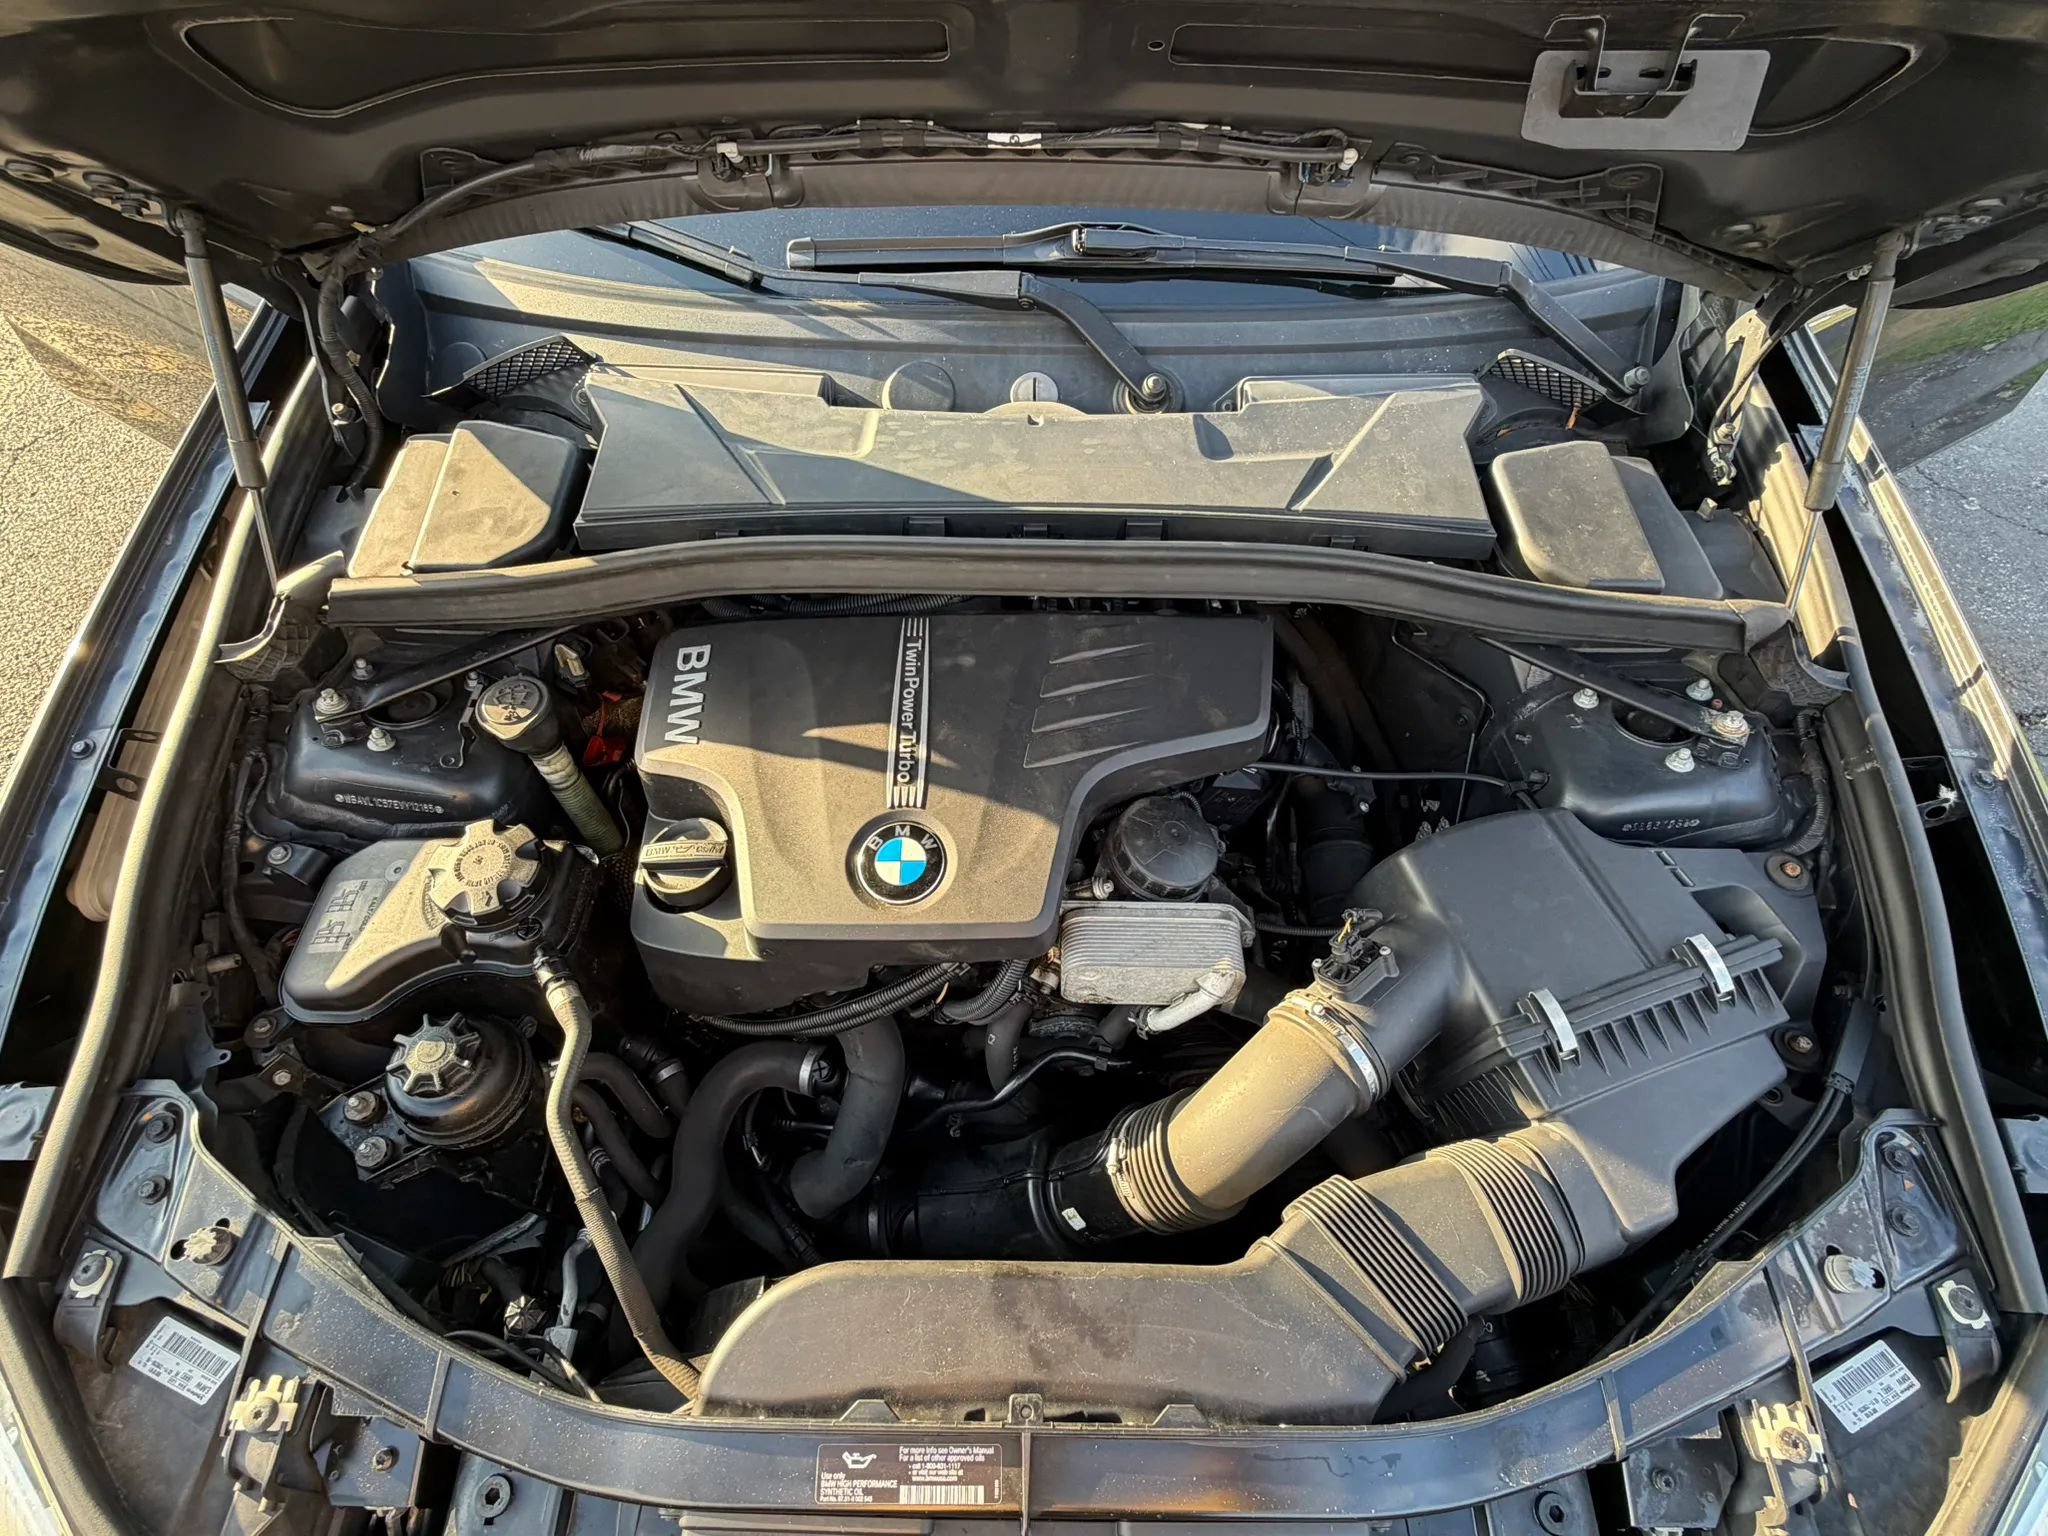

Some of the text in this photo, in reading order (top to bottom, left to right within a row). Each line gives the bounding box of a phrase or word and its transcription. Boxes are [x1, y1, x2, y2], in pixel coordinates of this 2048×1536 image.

[664, 644, 712, 744] BMW
[897, 638, 922, 783] TwinPower Turbo
[899, 1446, 909, 1454] For
[899, 1454, 909, 1462] For
[853, 1480, 898, 1488] PERFORMANCE
